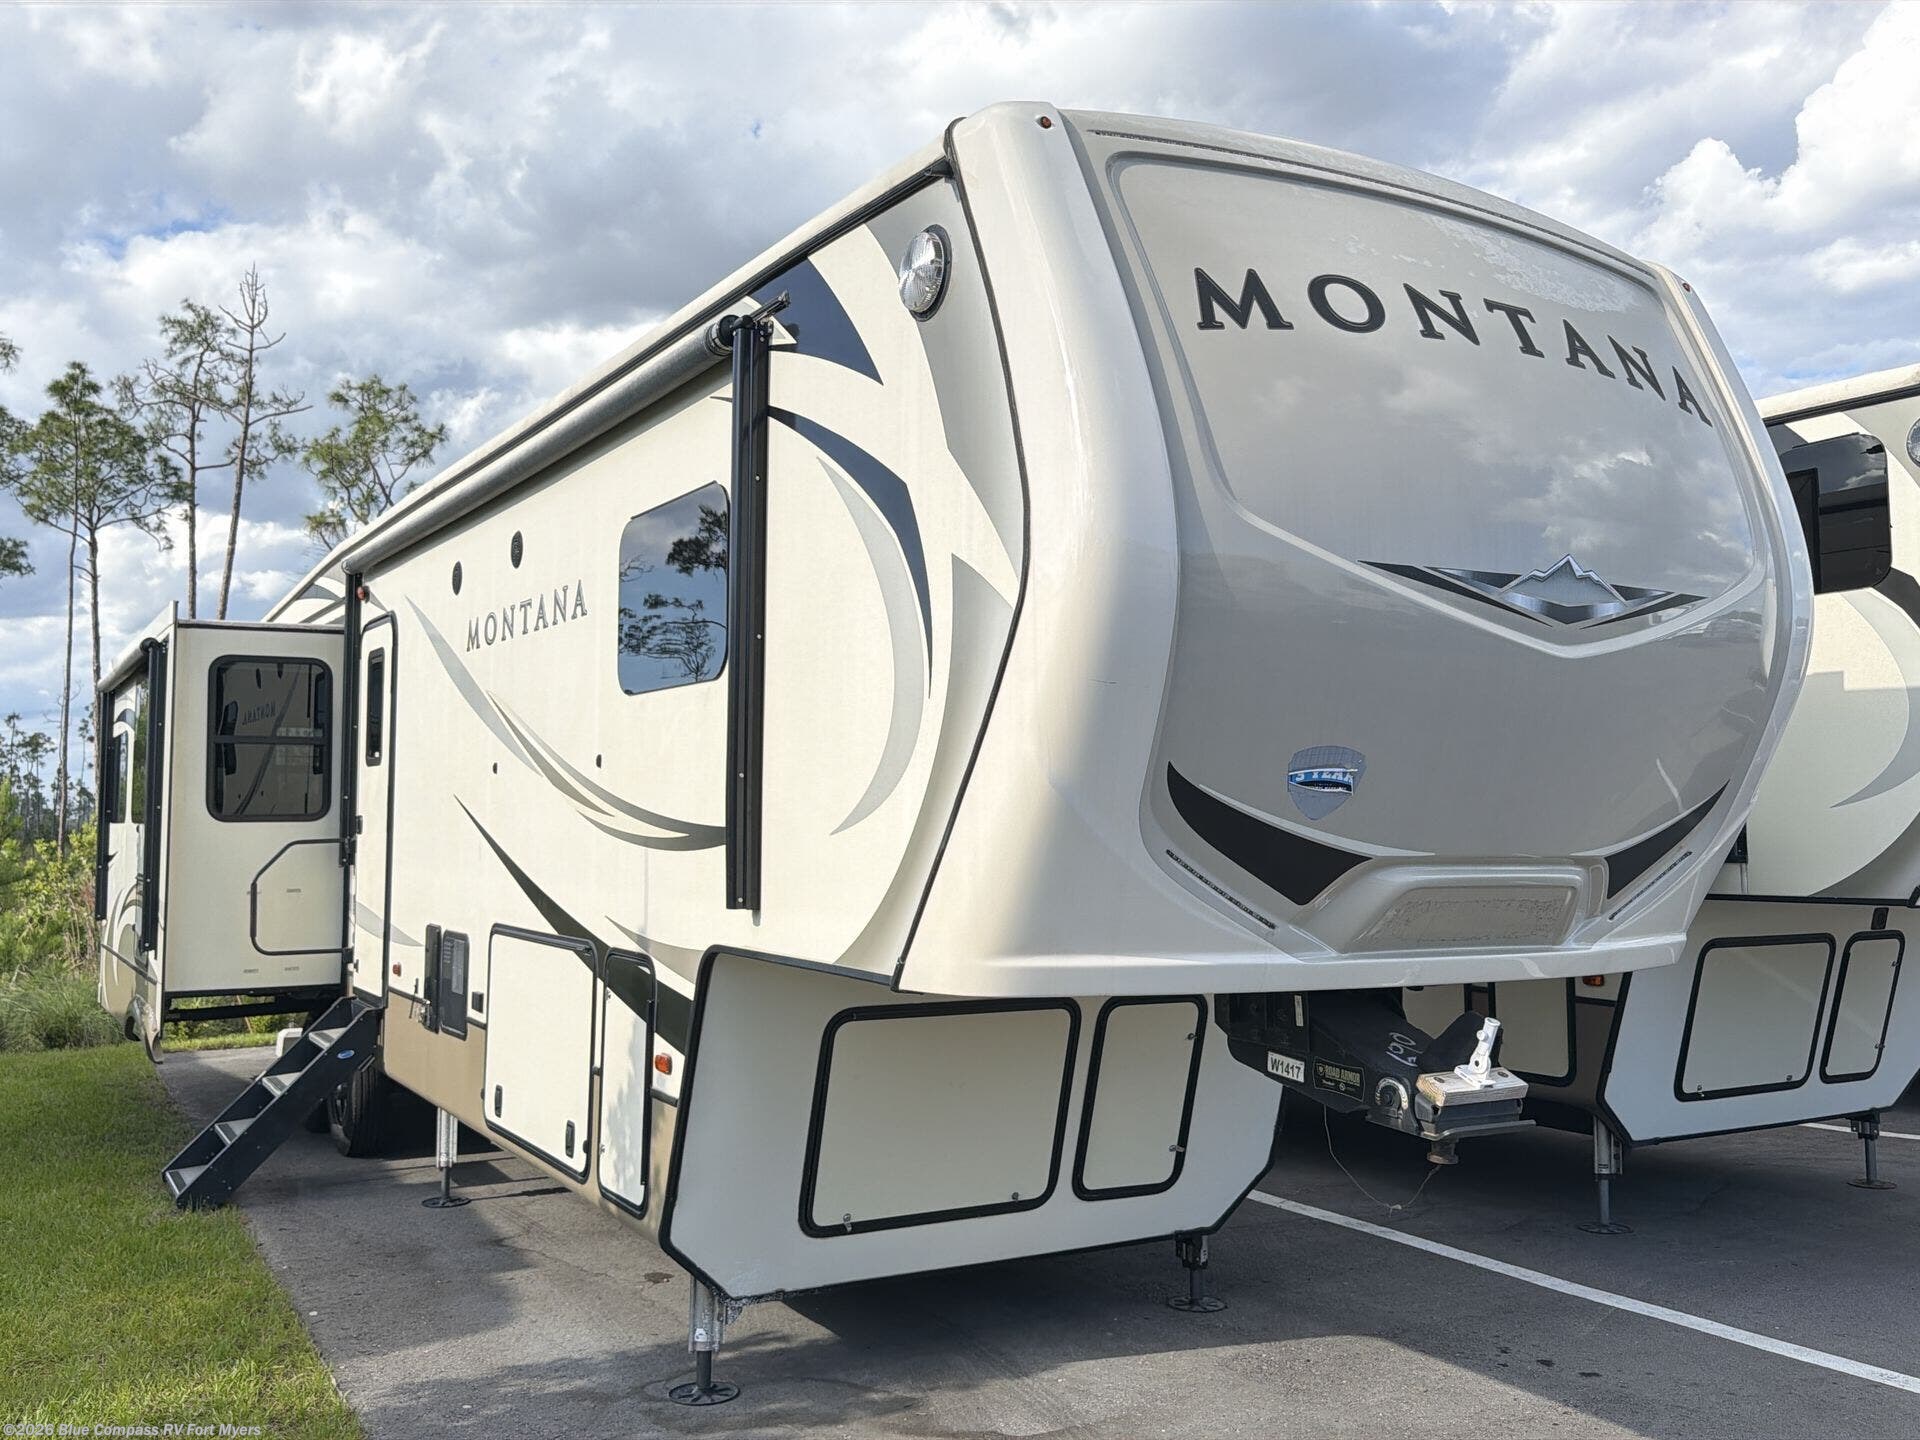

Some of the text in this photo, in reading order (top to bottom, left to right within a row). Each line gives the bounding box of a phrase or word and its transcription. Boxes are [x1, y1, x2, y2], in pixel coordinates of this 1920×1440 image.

[1194, 267, 1712, 427] MONTANA
[466, 579, 588, 652] MONTANA
[1270, 1056, 1301, 1079] W1417
